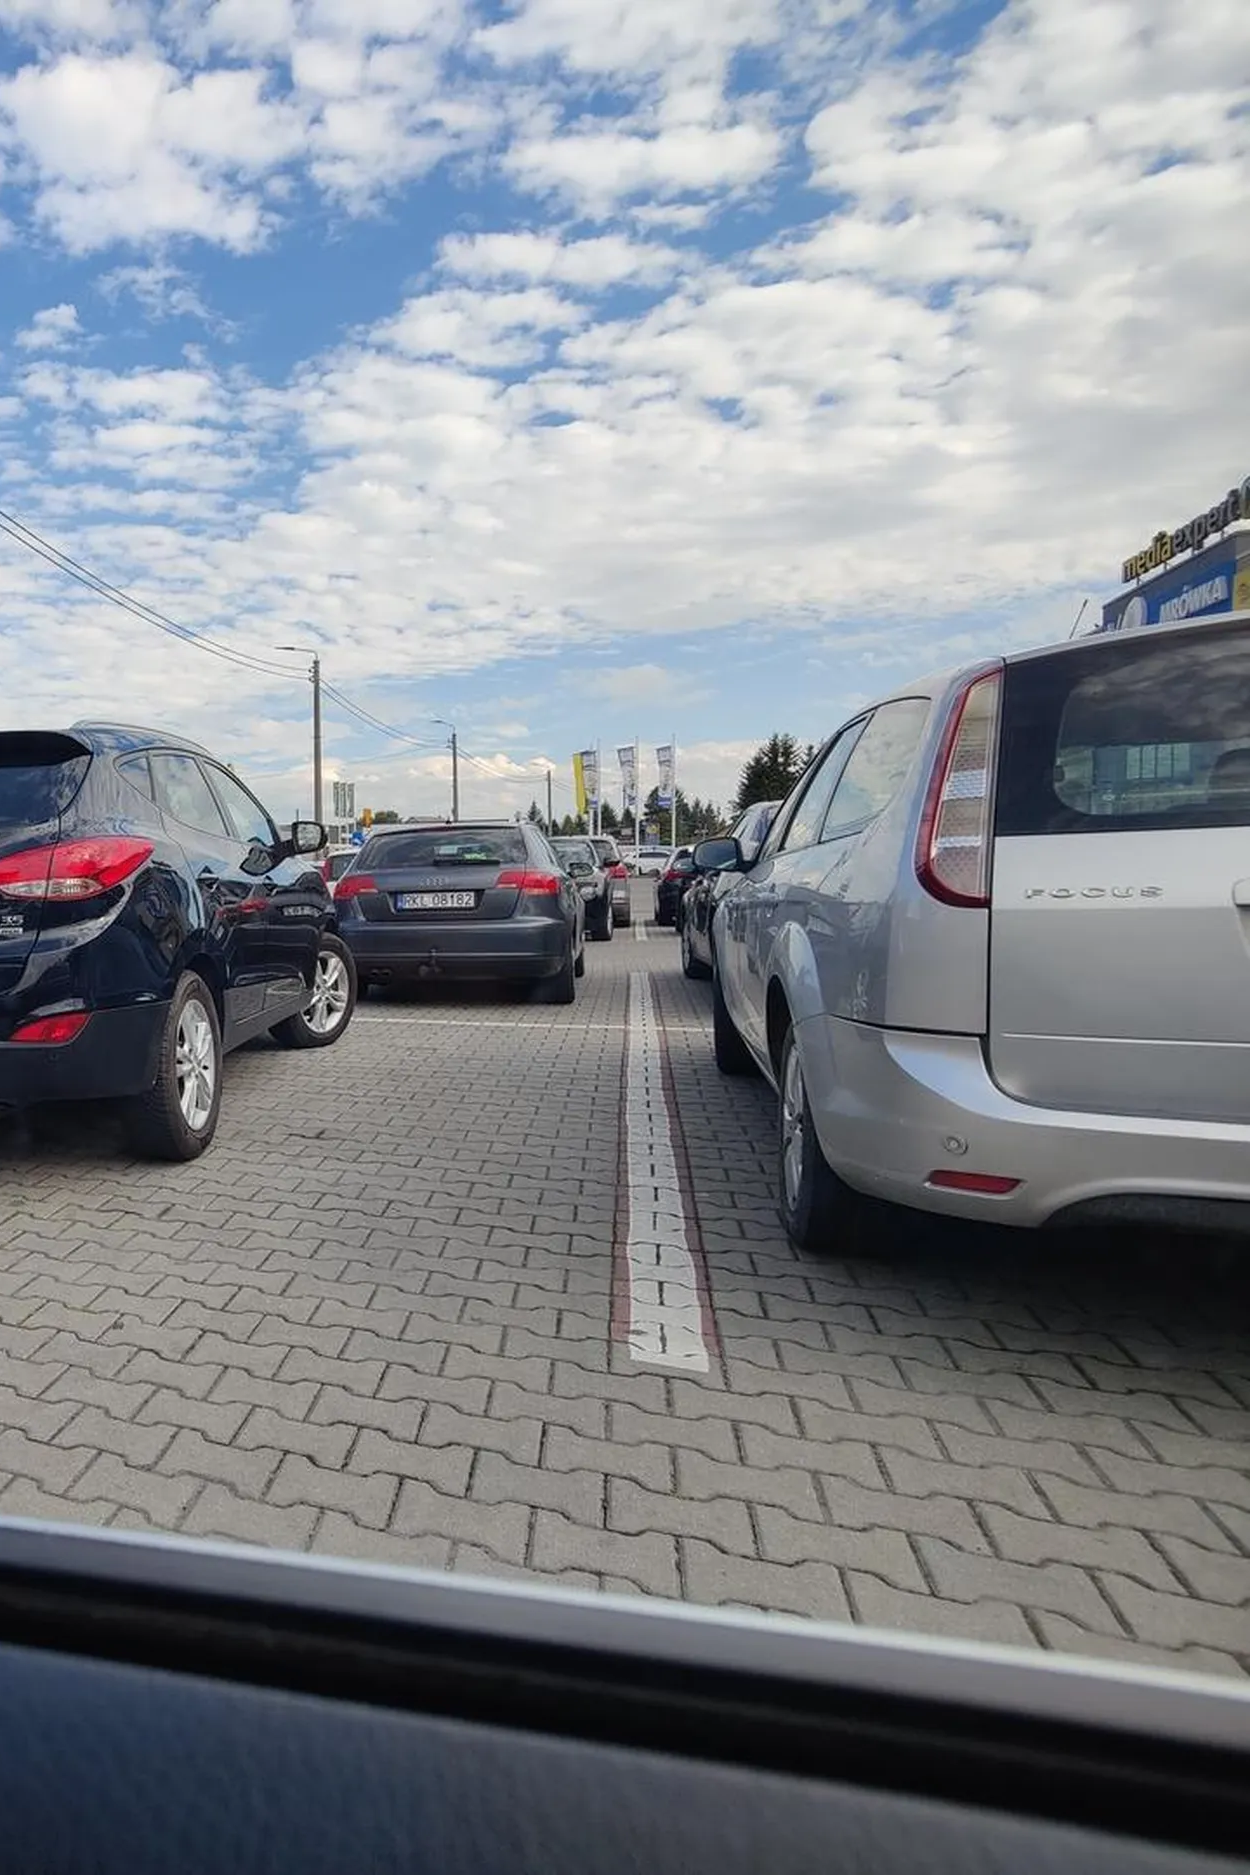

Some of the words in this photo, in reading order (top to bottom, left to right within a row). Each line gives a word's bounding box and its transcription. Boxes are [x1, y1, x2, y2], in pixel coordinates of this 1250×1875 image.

[403, 893, 427, 907] RKL
[432, 892, 472, 906] 08182
[1025, 886, 1163, 899] FOCUS
